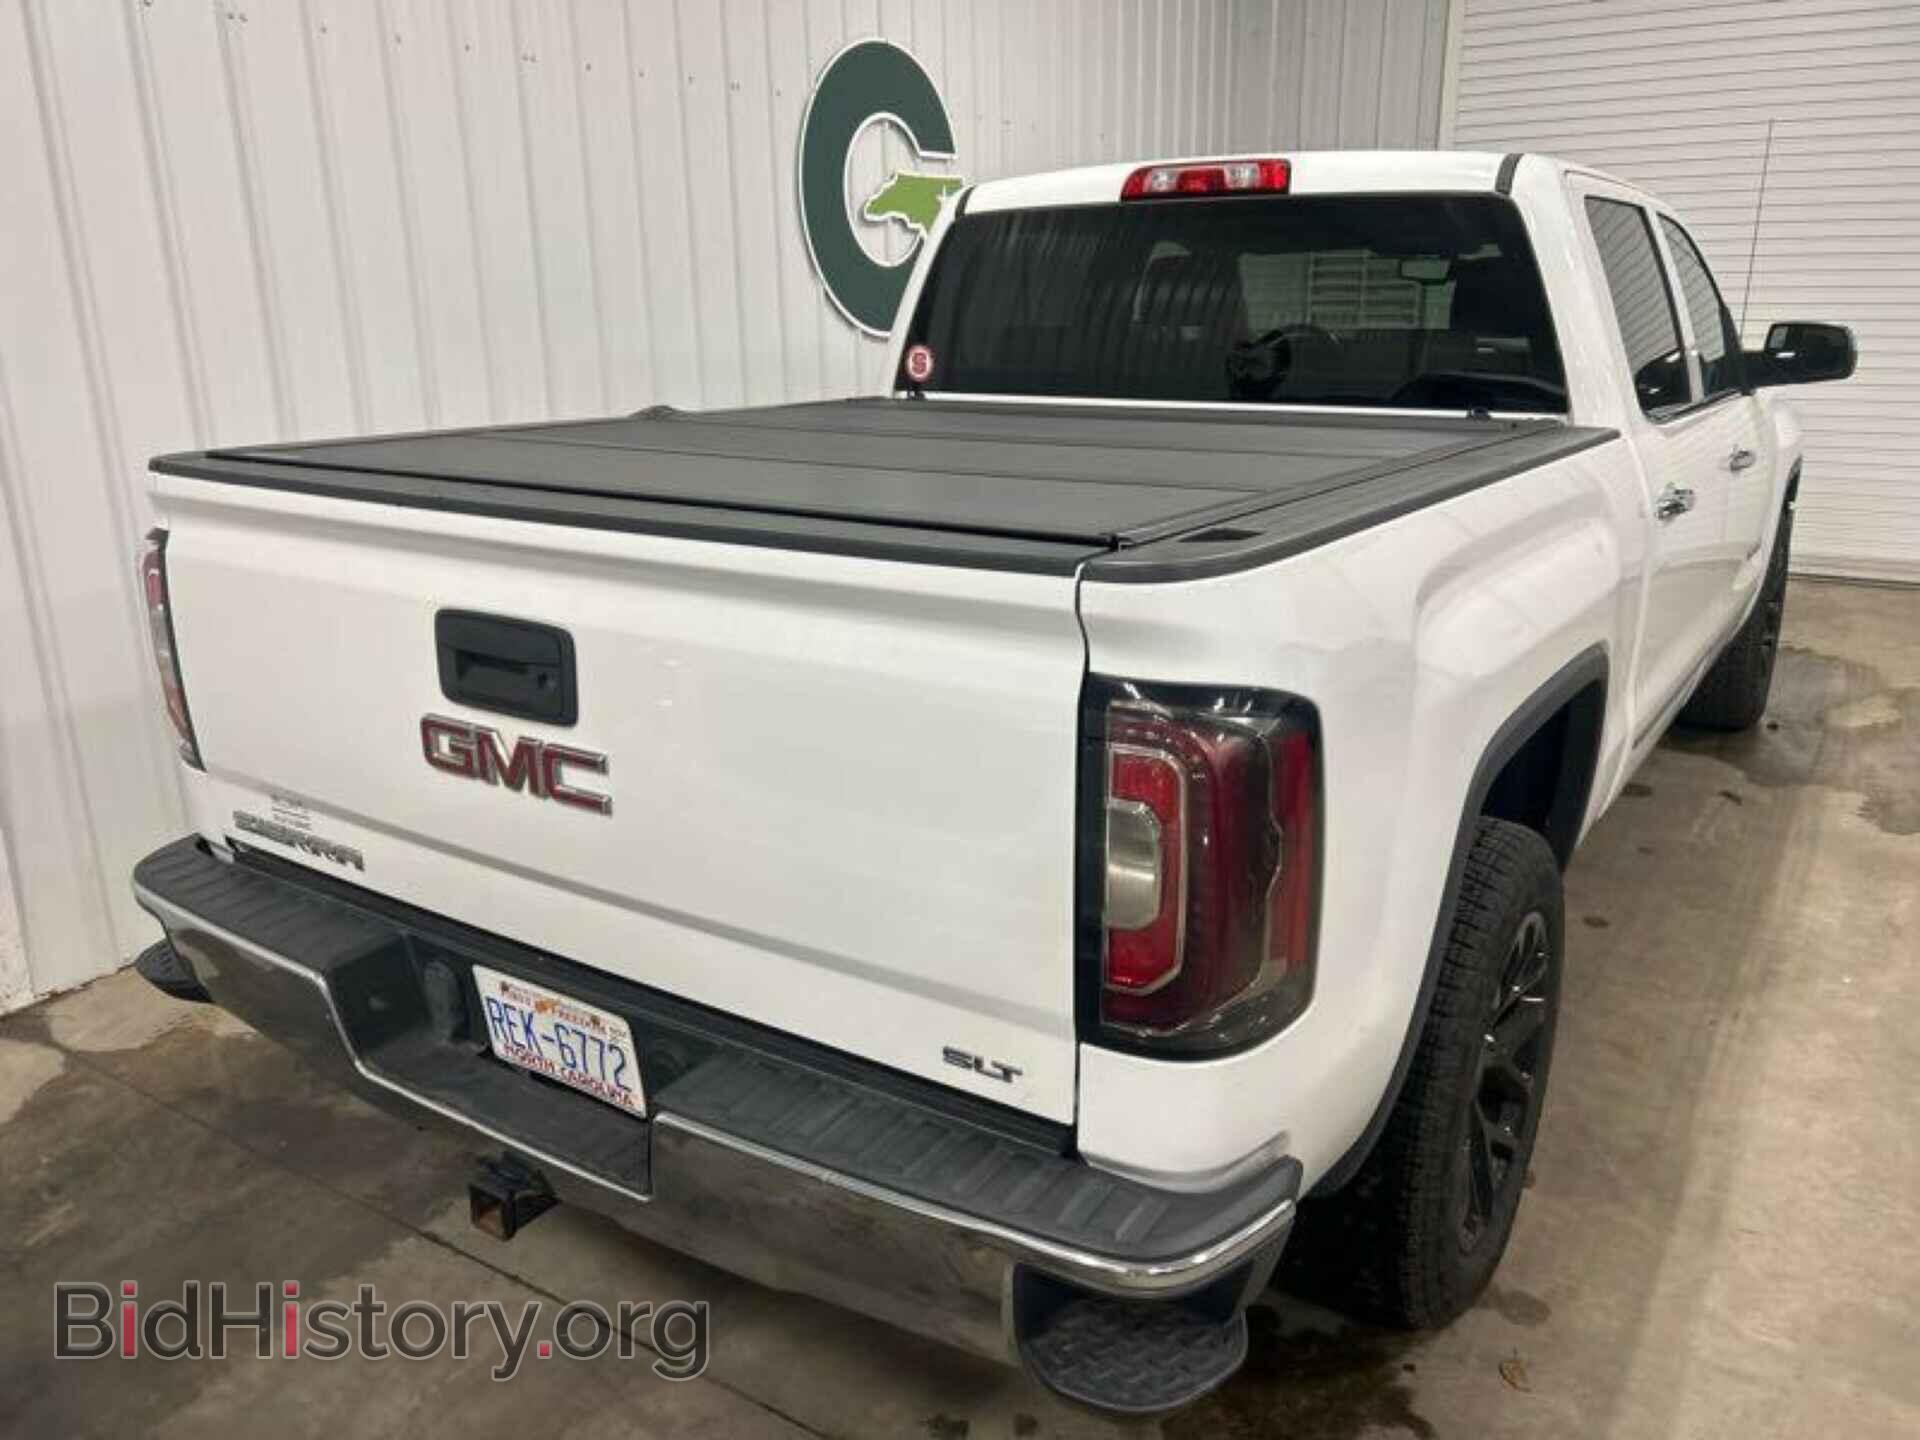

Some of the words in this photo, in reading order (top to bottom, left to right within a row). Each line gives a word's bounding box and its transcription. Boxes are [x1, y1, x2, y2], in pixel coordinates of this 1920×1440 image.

[420, 713, 613, 819] GMC
[484, 996, 633, 1093] REK-6772
[942, 1046, 1023, 1083] SLT
